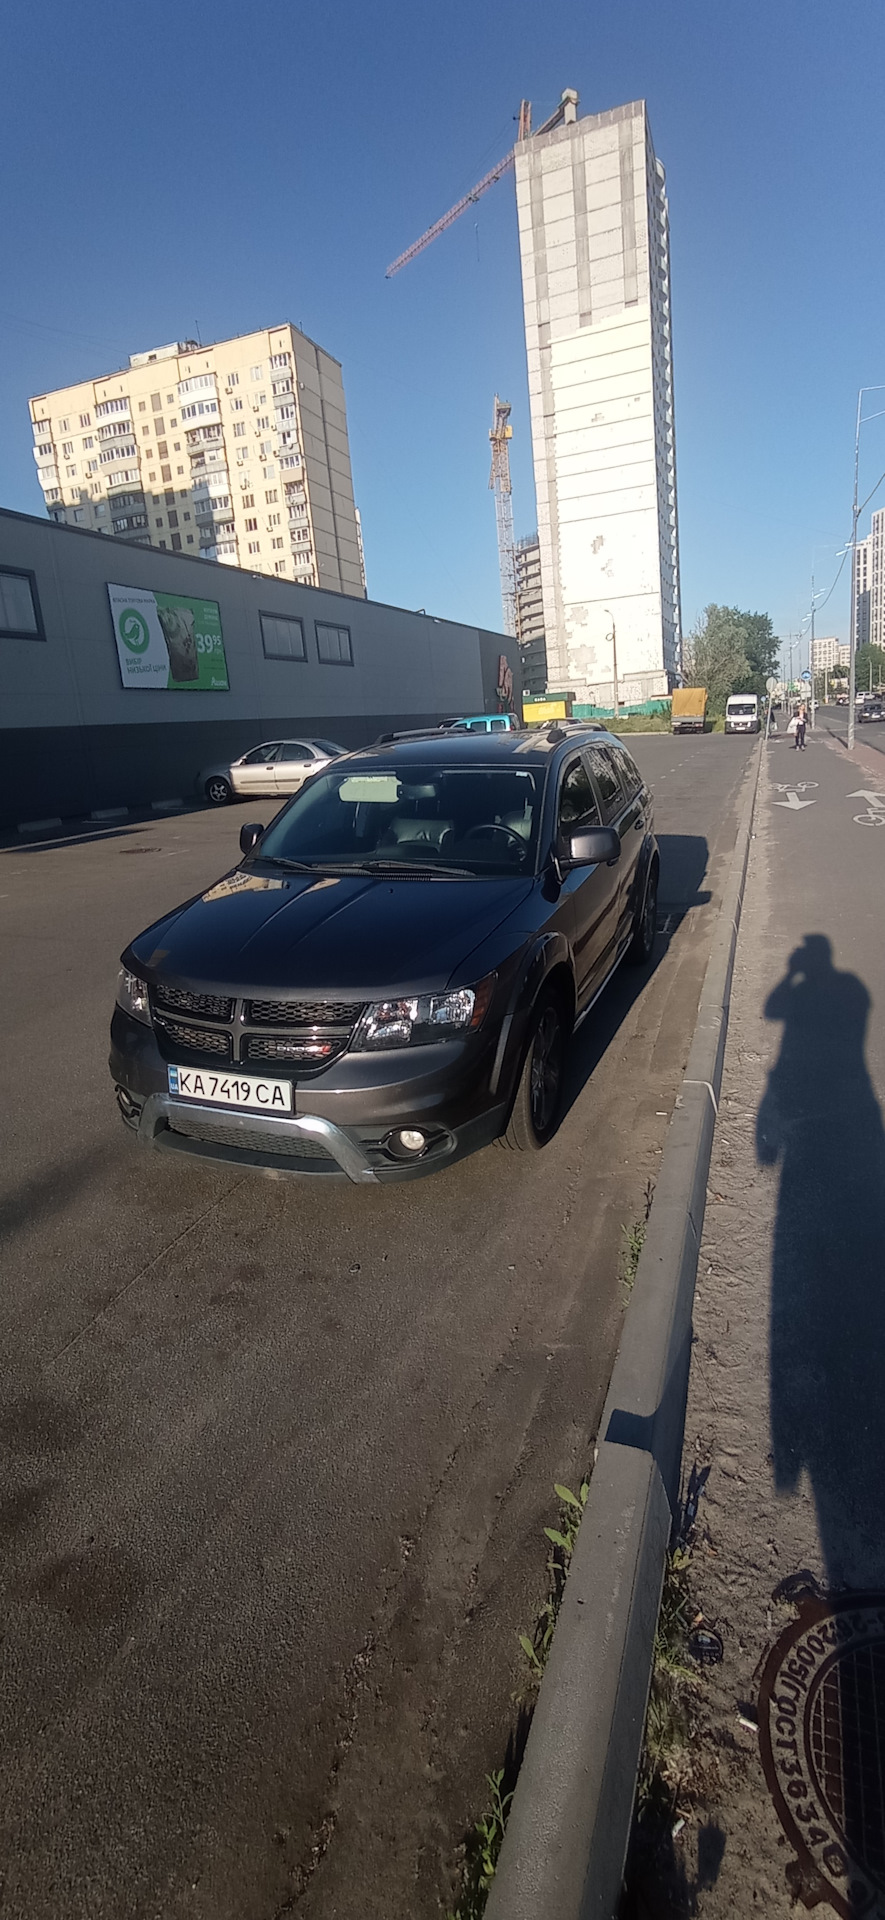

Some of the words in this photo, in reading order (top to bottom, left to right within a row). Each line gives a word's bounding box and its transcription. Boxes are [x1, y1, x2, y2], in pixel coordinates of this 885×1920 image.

[195, 633, 213, 654] 39
[212, 635, 221, 646] 95
[208, 1077, 251, 1101] 7419
